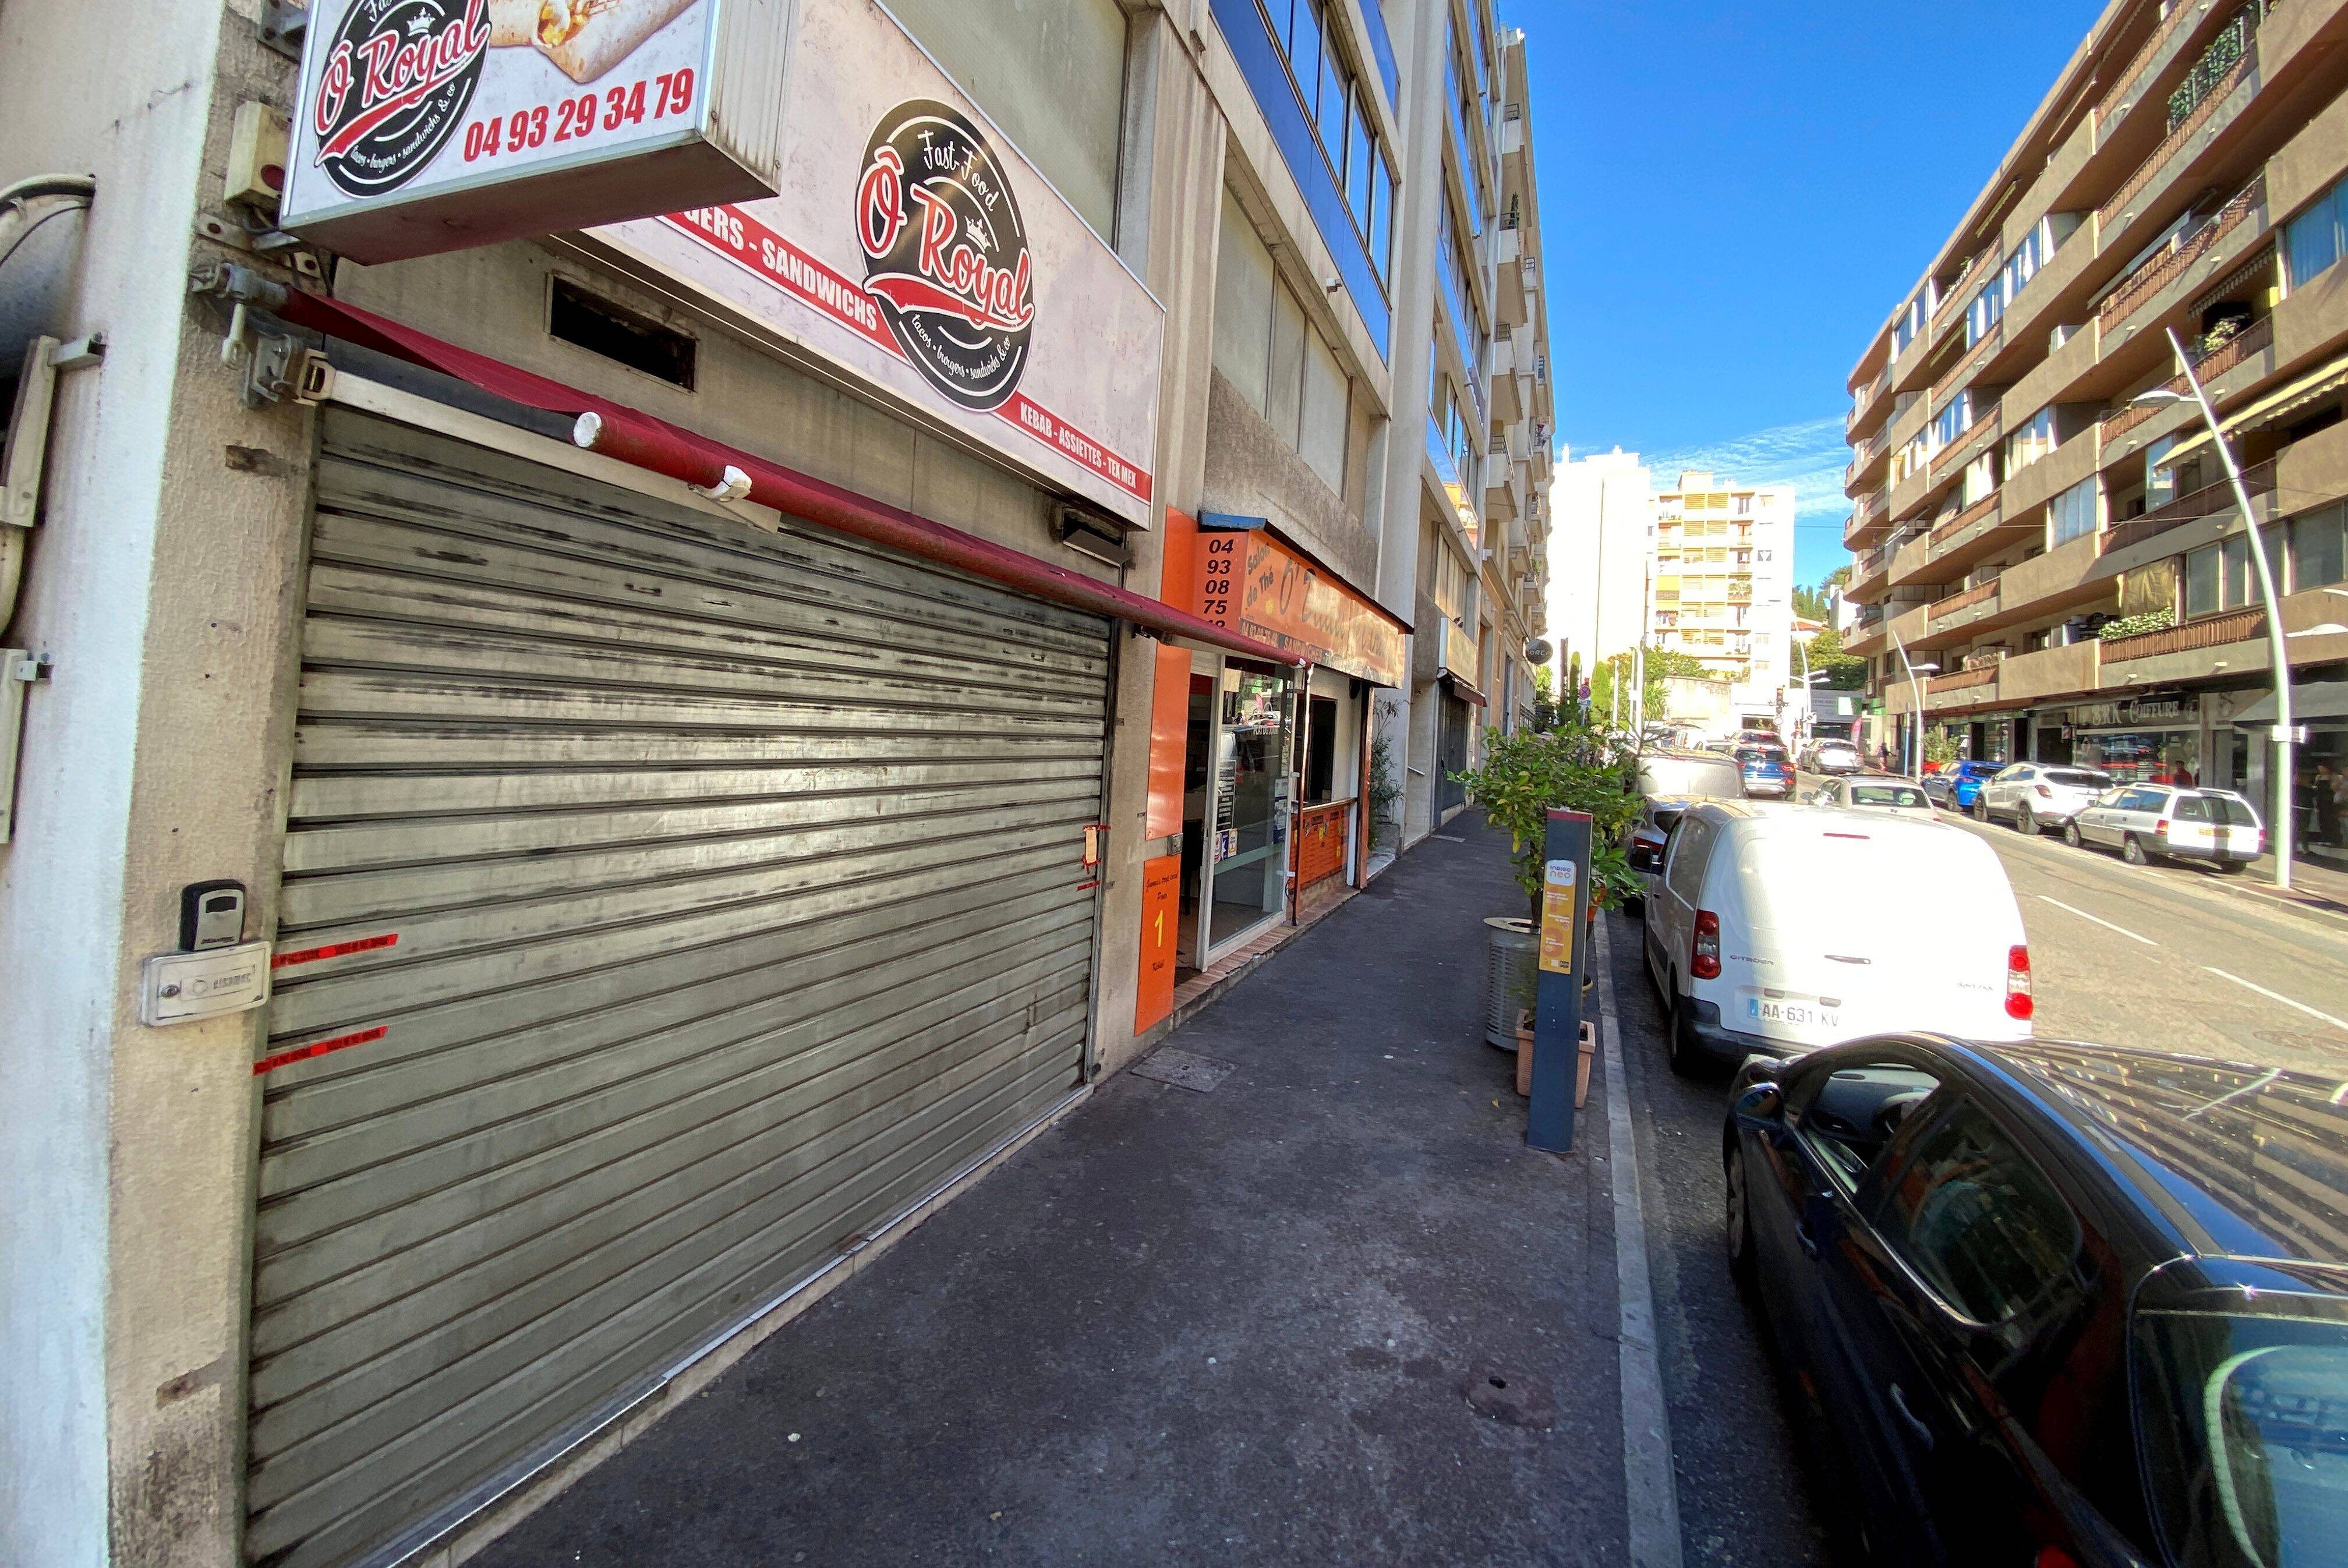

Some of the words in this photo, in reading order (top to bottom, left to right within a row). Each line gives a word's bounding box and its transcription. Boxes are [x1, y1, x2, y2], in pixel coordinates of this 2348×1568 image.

[357, 0, 491, 108] Royal
[464, 117, 502, 162] 04
[508, 105, 549, 152] 93
[554, 94, 597, 142] 29
[603, 80, 646, 130] 34
[654, 68, 694, 120] 79
[917, 130, 959, 170] Fast
[961, 146, 999, 211] Food
[762, 237, 877, 331] SANDWICHS
[910, 183, 1034, 324] Royal
[912, 313, 932, 348] tacos
[937, 345, 965, 377] burgers
[1020, 401, 1052, 438] KEBAB
[1059, 426, 1102, 468] ASSIETTES
[1107, 456, 1121, 479] TEX
[1122, 466, 1136, 489] MEX
[1207, 560, 1231, 574] 93
[1209, 539, 1234, 554] 04
[1204, 600, 1228, 615] 75
[1205, 579, 1230, 594] 08
[1550, 870, 1571, 879] neo
